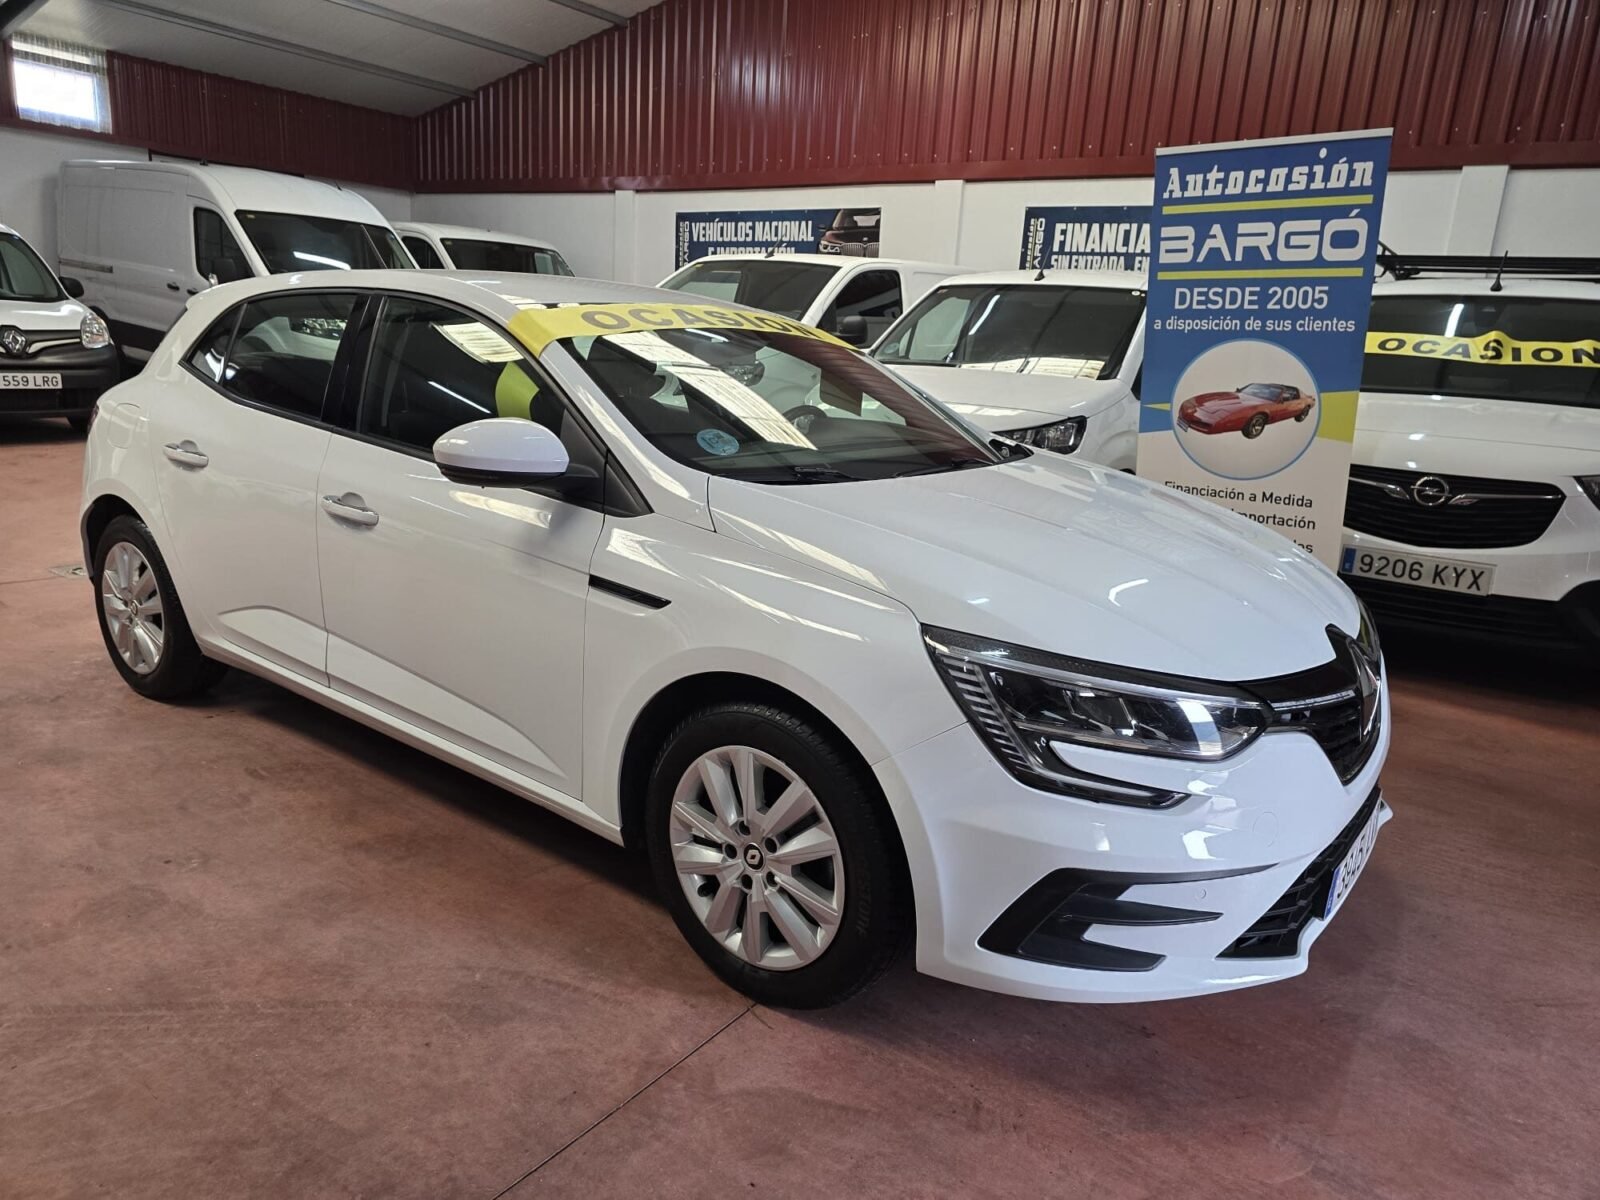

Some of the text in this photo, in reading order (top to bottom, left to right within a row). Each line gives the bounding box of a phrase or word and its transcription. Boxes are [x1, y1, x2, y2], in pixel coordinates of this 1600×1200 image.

[1162, 147, 1374, 199] Autocasión
[691, 218, 815, 242] VEHÍCULOS NACIONAL
[1052, 222, 1151, 253] FINANCIA
[1158, 208, 1369, 264] BARGÓ
[1050, 254, 1070, 270] SIN
[1070, 255, 1125, 271] ENTRADA
[1174, 286, 1329, 310] DESDE 2005
[581, 308, 822, 339] OCASION
[1153, 316, 1356, 333] a disposición de sus clientes
[1377, 338, 1600, 365] OCASION
[2, 375, 59, 388] 559 LRG
[1249, 492, 1257, 502] a
[1261, 491, 1313, 508] Medida
[1358, 553, 1485, 592] 9206 KYX
